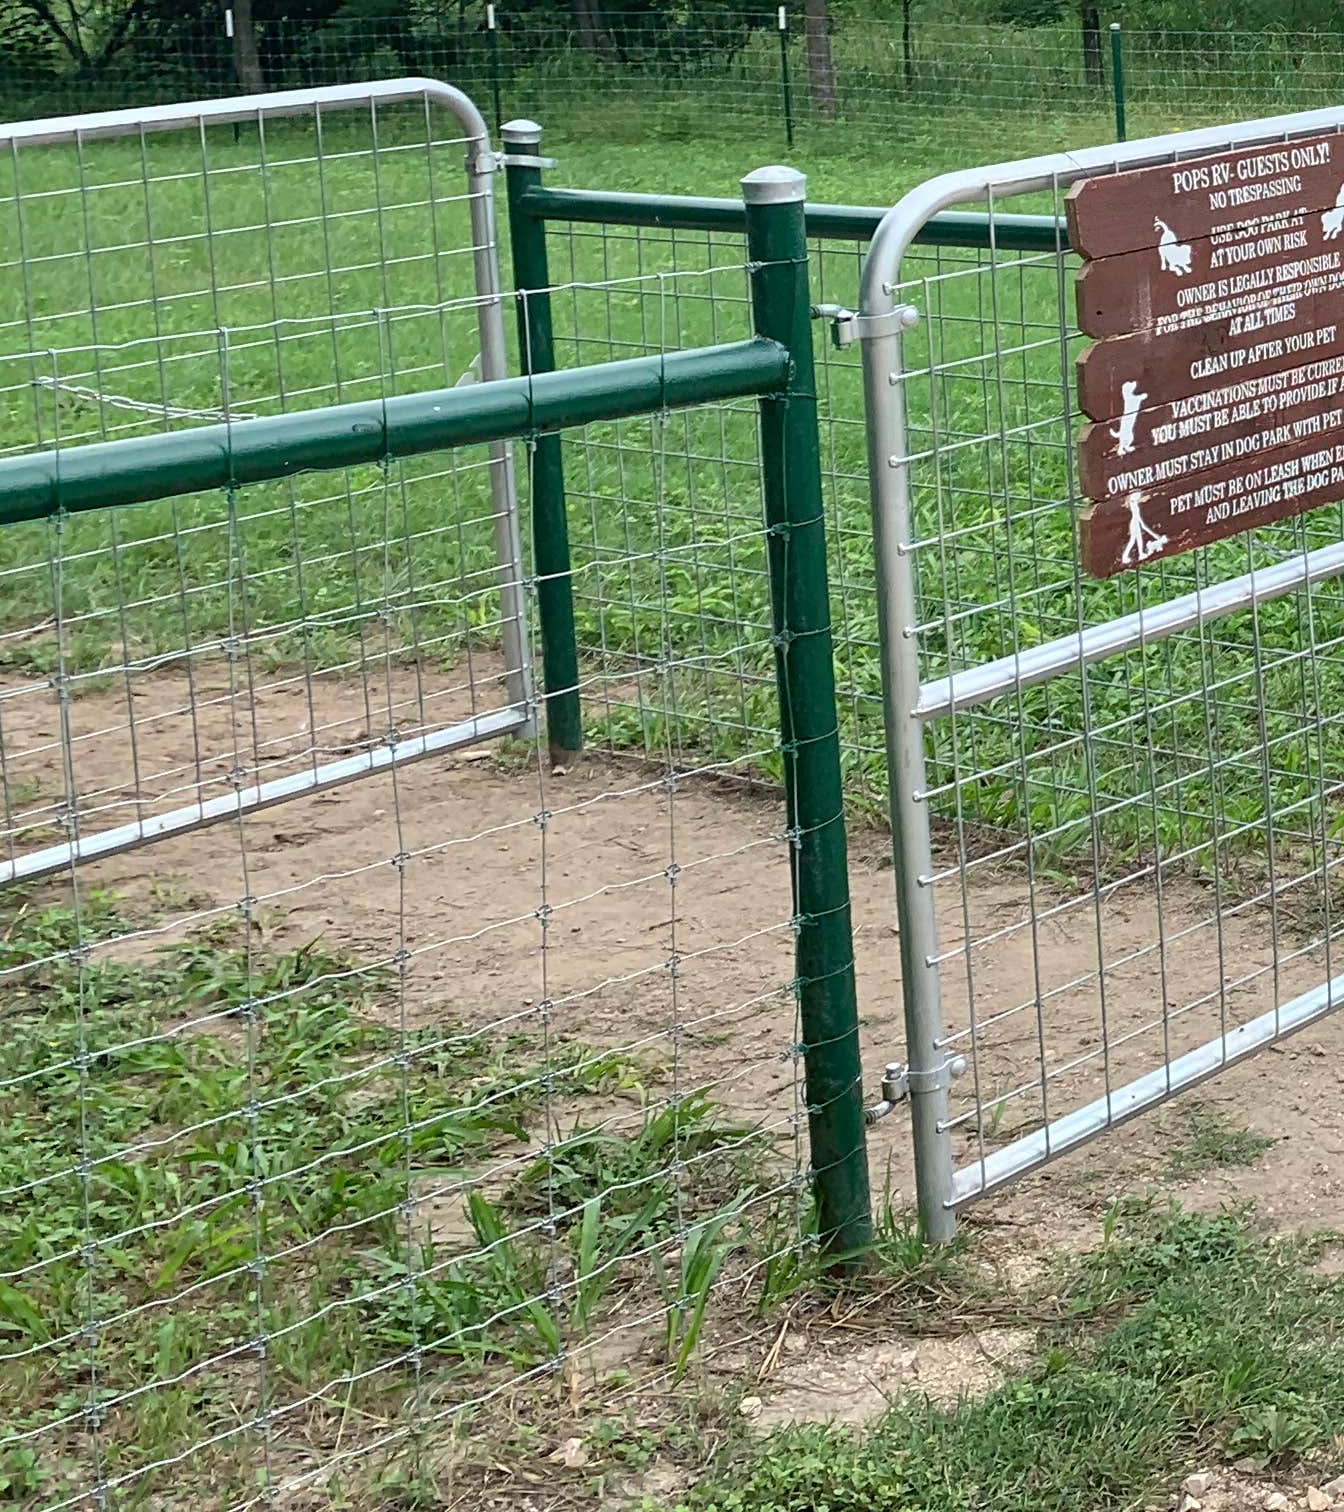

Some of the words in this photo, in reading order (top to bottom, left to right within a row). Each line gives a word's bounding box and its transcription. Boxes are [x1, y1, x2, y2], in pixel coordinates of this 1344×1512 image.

[1173, 168, 1209, 194] POPS
[1237, 152, 1289, 180] GUESTS
[1291, 142, 1330, 169] ONLY!
[1209, 192, 1227, 210] NO
[1228, 175, 1302, 207] TRESPASSING
[1210, 224, 1234, 245] USE
[1235, 217, 1259, 240] DOG
[1261, 211, 1292, 234] PARK
[1292, 207, 1308, 226] AT
[1210, 248, 1225, 269] AT
[1225, 242, 1256, 264] YOUR
[1257, 235, 1282, 257] OWN
[1283, 230, 1308, 250] RISK
[1177, 282, 1215, 307] OWNER
[1218, 278, 1229, 298] IS
[1229, 267, 1275, 295] LEGALLY
[1276, 252, 1341, 284] RESPONSIBLE
[1229, 316, 1244, 336] AT
[1244, 310, 1264, 332] ALL
[1264, 303, 1296, 326] TIMES
[1190, 353, 1228, 379] CLEAN
[1230, 347, 1247, 368] UP
[1247, 339, 1283, 364] AFTER
[1284, 331, 1315, 354] YOUR
[1316, 326, 1336, 346] PET
[1151, 423, 1176, 446] YOU
[1178, 413, 1212, 439] MUST
[1214, 409, 1229, 428] BE
[1231, 399, 1261, 423] ABLE
[1261, 395, 1277, 414] TO
[1279, 381, 1327, 410] PROVIDE
[1327, 378, 1338, 396] IF
[1171, 380, 1257, 419] VACCINATIONS
[1257, 370, 1291, 395] MUST
[1291, 366, 1306, 386] BE
[1108, 466, 1154, 495] OWNER
[1155, 455, 1189, 481] MUST
[1190, 446, 1222, 470] STAY
[1221, 440, 1236, 460] IN
[1236, 433, 1260, 456] DOG
[1262, 424, 1291, 449] PARK
[1292, 414, 1320, 438] WITH
[1322, 408, 1342, 430] PET
[1169, 494, 1195, 516] PET
[1195, 482, 1227, 507] MUST
[1228, 476, 1245, 498] BE
[1245, 472, 1263, 491] ON
[1263, 459, 1299, 485] LEASH
[1300, 448, 1334, 473] WHEN
[1205, 502, 1230, 524] AND
[1231, 484, 1281, 516] LEAVING
[1282, 477, 1306, 500] THE
[1306, 470, 1330, 492] DOG
